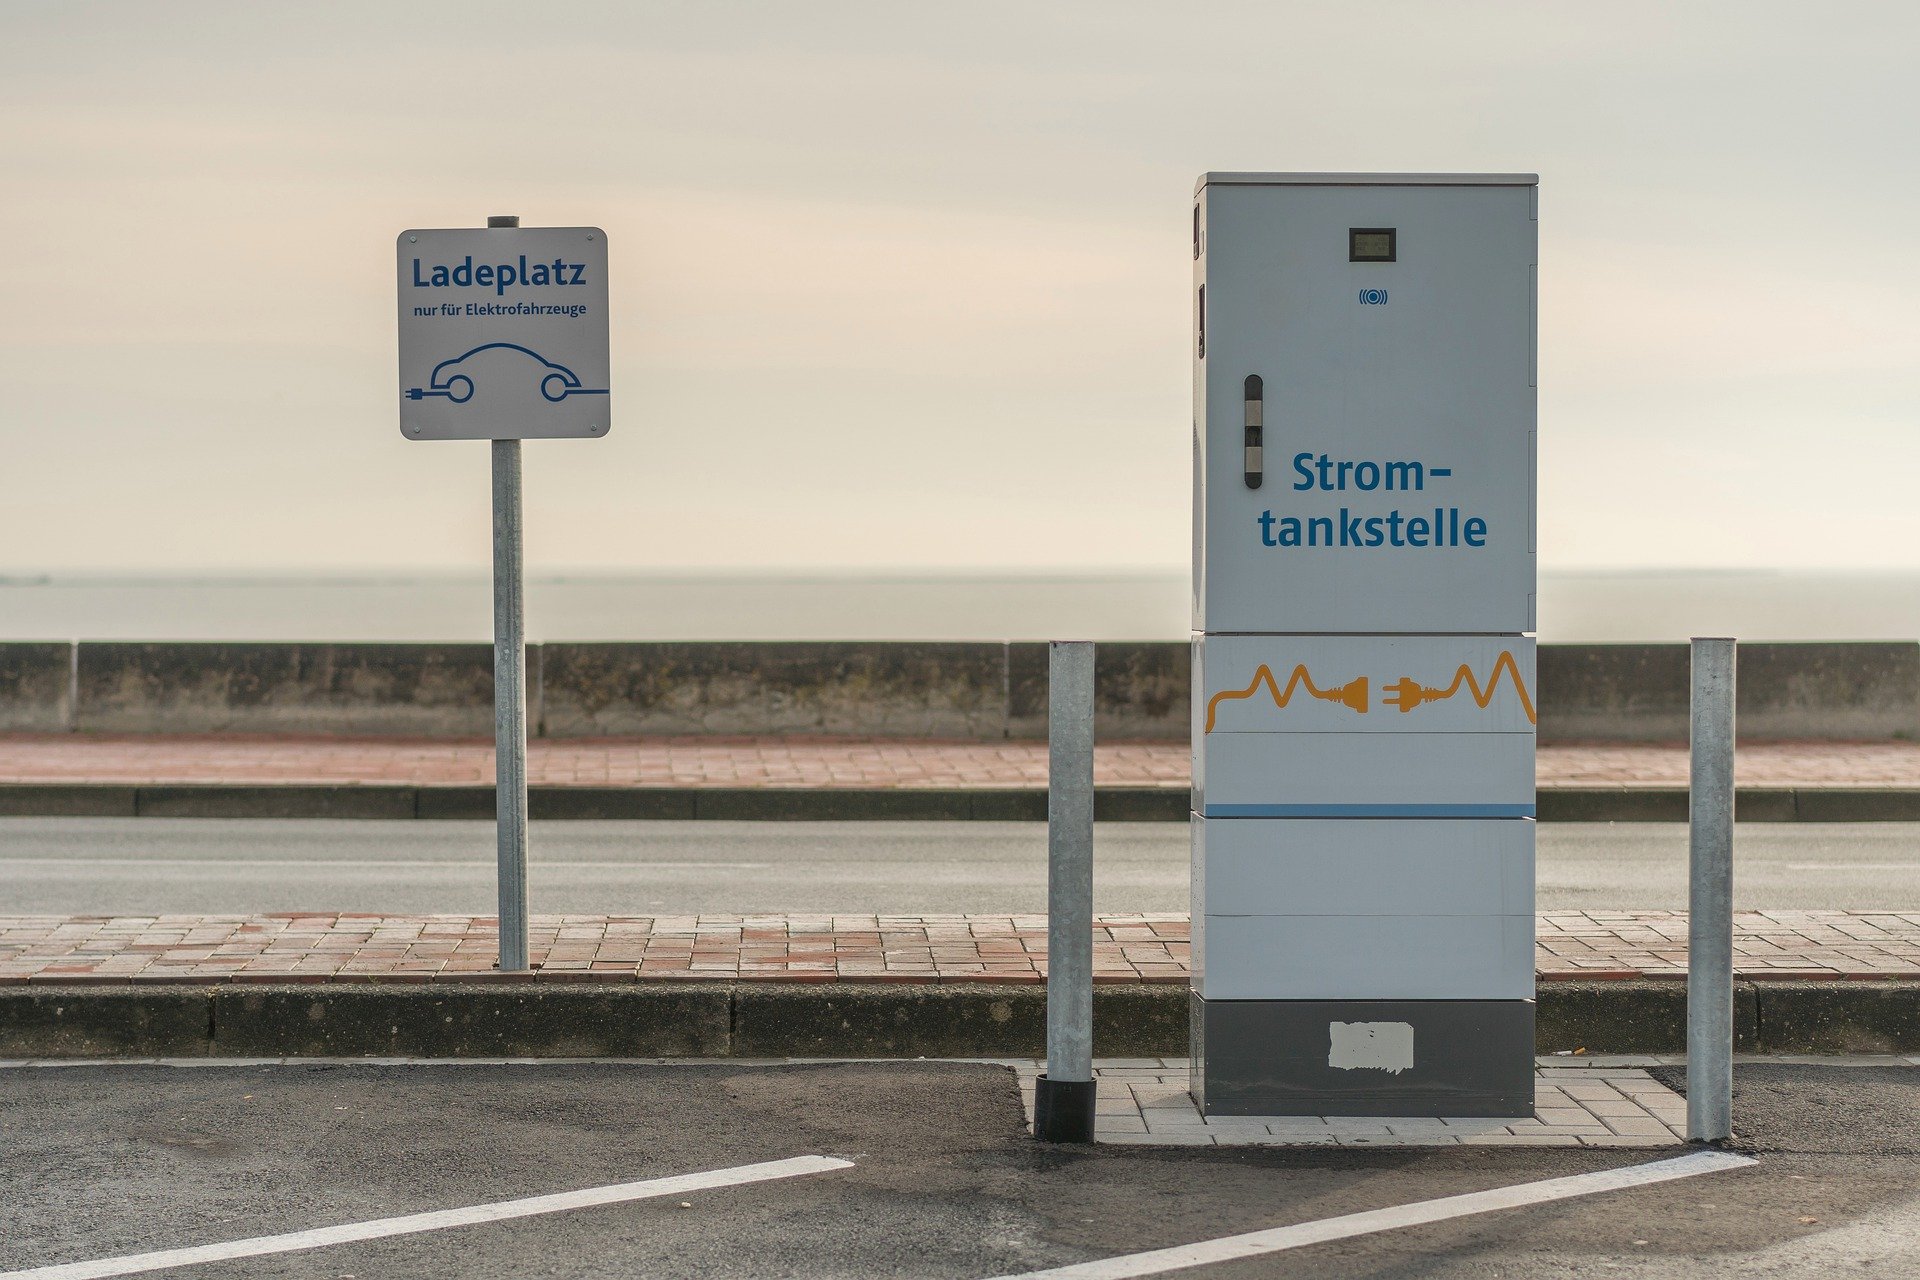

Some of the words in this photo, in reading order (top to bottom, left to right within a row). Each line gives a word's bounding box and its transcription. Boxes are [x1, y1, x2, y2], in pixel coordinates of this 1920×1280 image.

[413, 255, 587, 296] Ladeplatz
[414, 305, 438, 317] nur
[441, 303, 462, 316] für
[466, 302, 587, 318] Elektrofahrzeuge
[1293, 452, 1452, 491] Strom-
[1257, 507, 1488, 547] tankstelle
